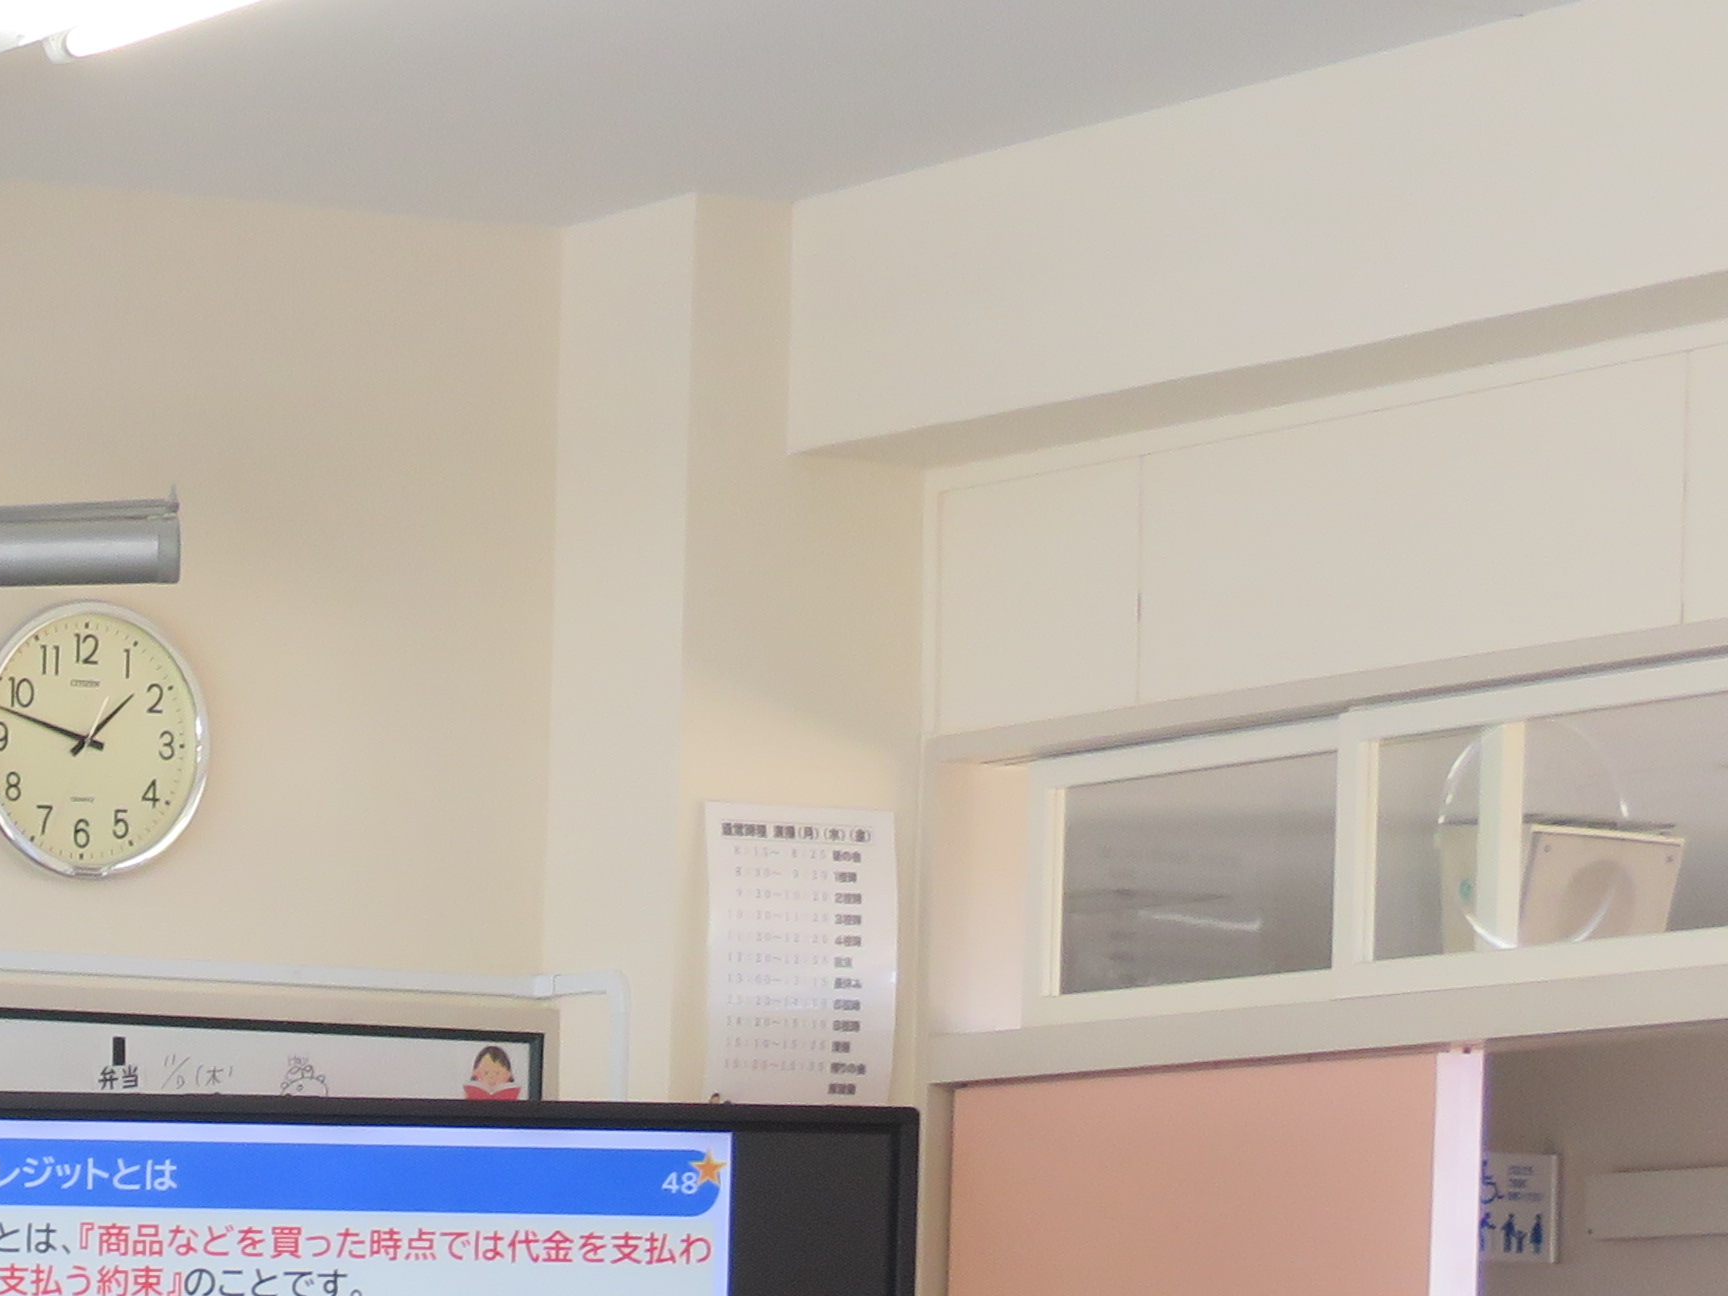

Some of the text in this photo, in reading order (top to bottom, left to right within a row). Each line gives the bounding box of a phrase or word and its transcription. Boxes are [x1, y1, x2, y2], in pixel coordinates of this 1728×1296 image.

[40, 645, 61, 676] 11
[74, 633, 100, 665] 12
[123, 648, 131, 679] 1
[8, 676, 35, 708] 10
[146, 683, 164, 714] 2
[158, 730, 175, 760] 3
[5, 771, 21, 801] 8
[141, 778, 160, 808] 4
[36, 804, 53, 836] 7
[73, 818, 90, 849] 6
[112, 808, 129, 839] 5
[97, 1065, 139, 1091] 弁当
[661, 1172, 699, 1196] 48
